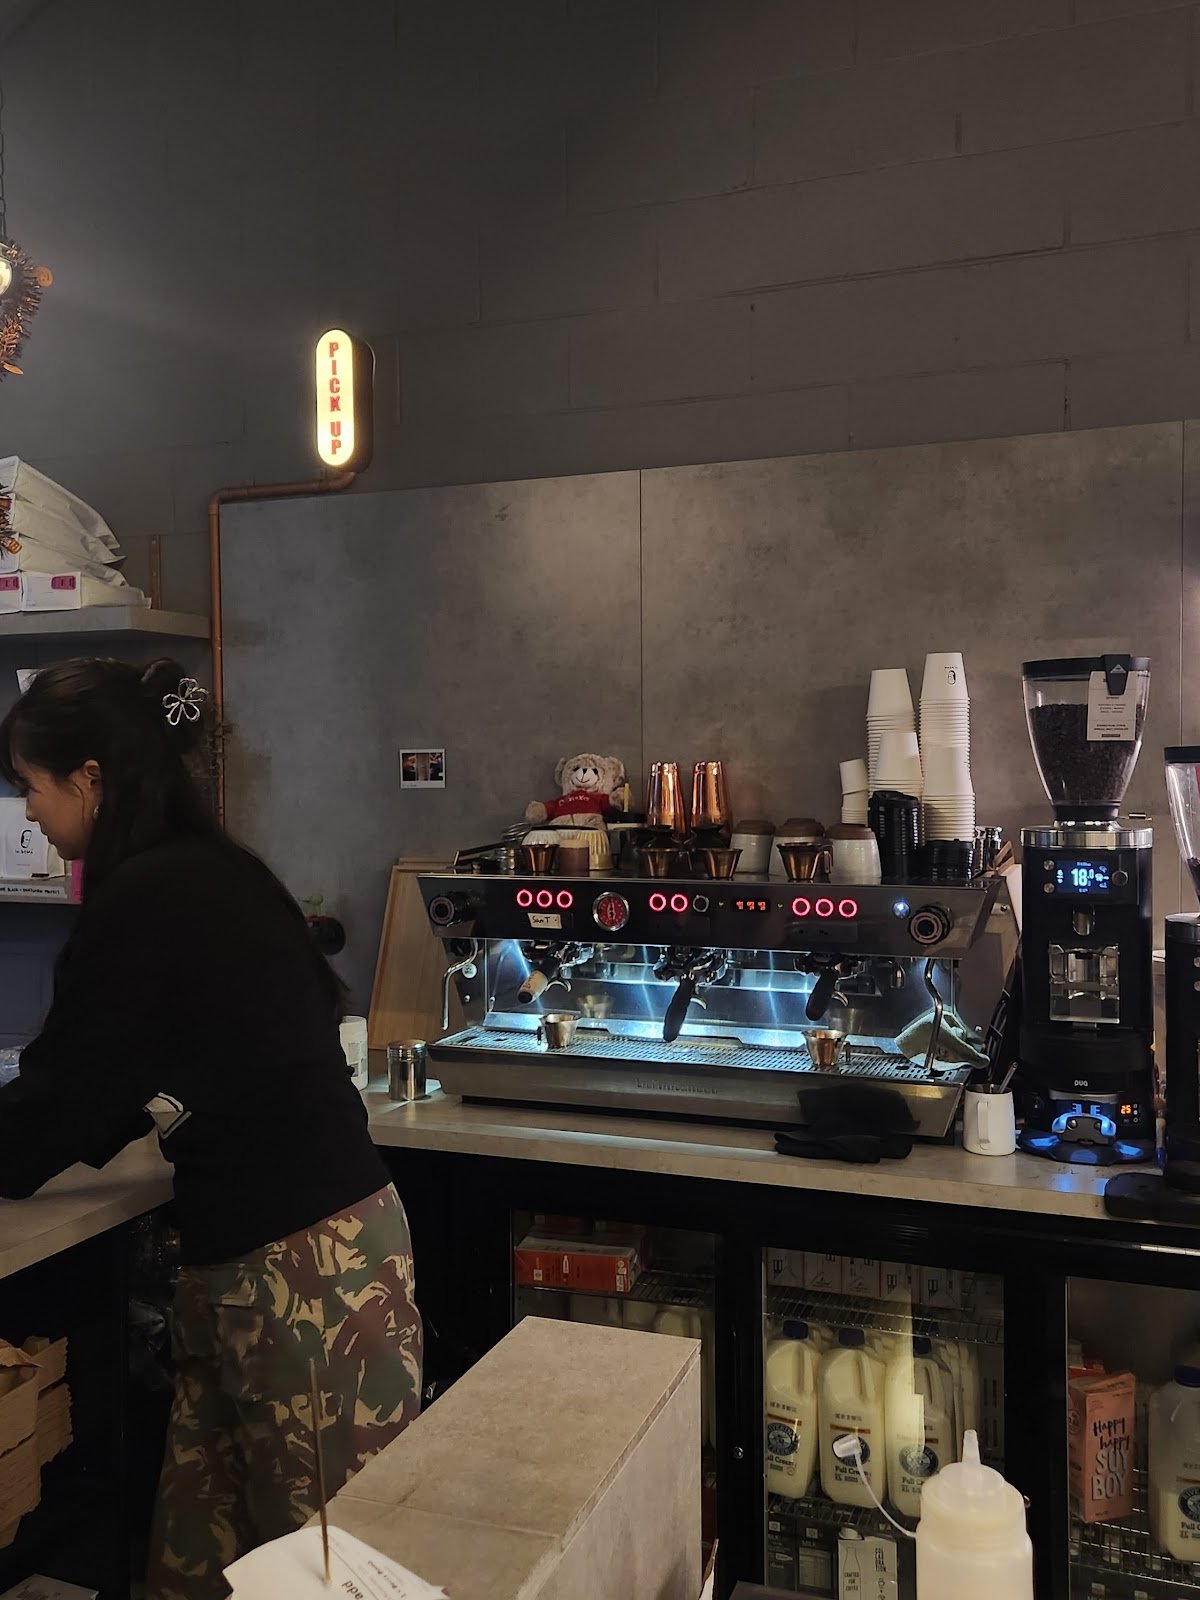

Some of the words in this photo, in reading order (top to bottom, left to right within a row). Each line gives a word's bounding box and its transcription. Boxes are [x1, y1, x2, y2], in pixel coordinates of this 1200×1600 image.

[329, 342, 341, 412] PICK
[330, 421, 341, 455] UP
[1120, 1104, 1132, 1115] 25
[1093, 1416, 1125, 1436] Happy
[1100, 1434, 1130, 1451] happy
[1092, 1473, 1127, 1501] BOY
